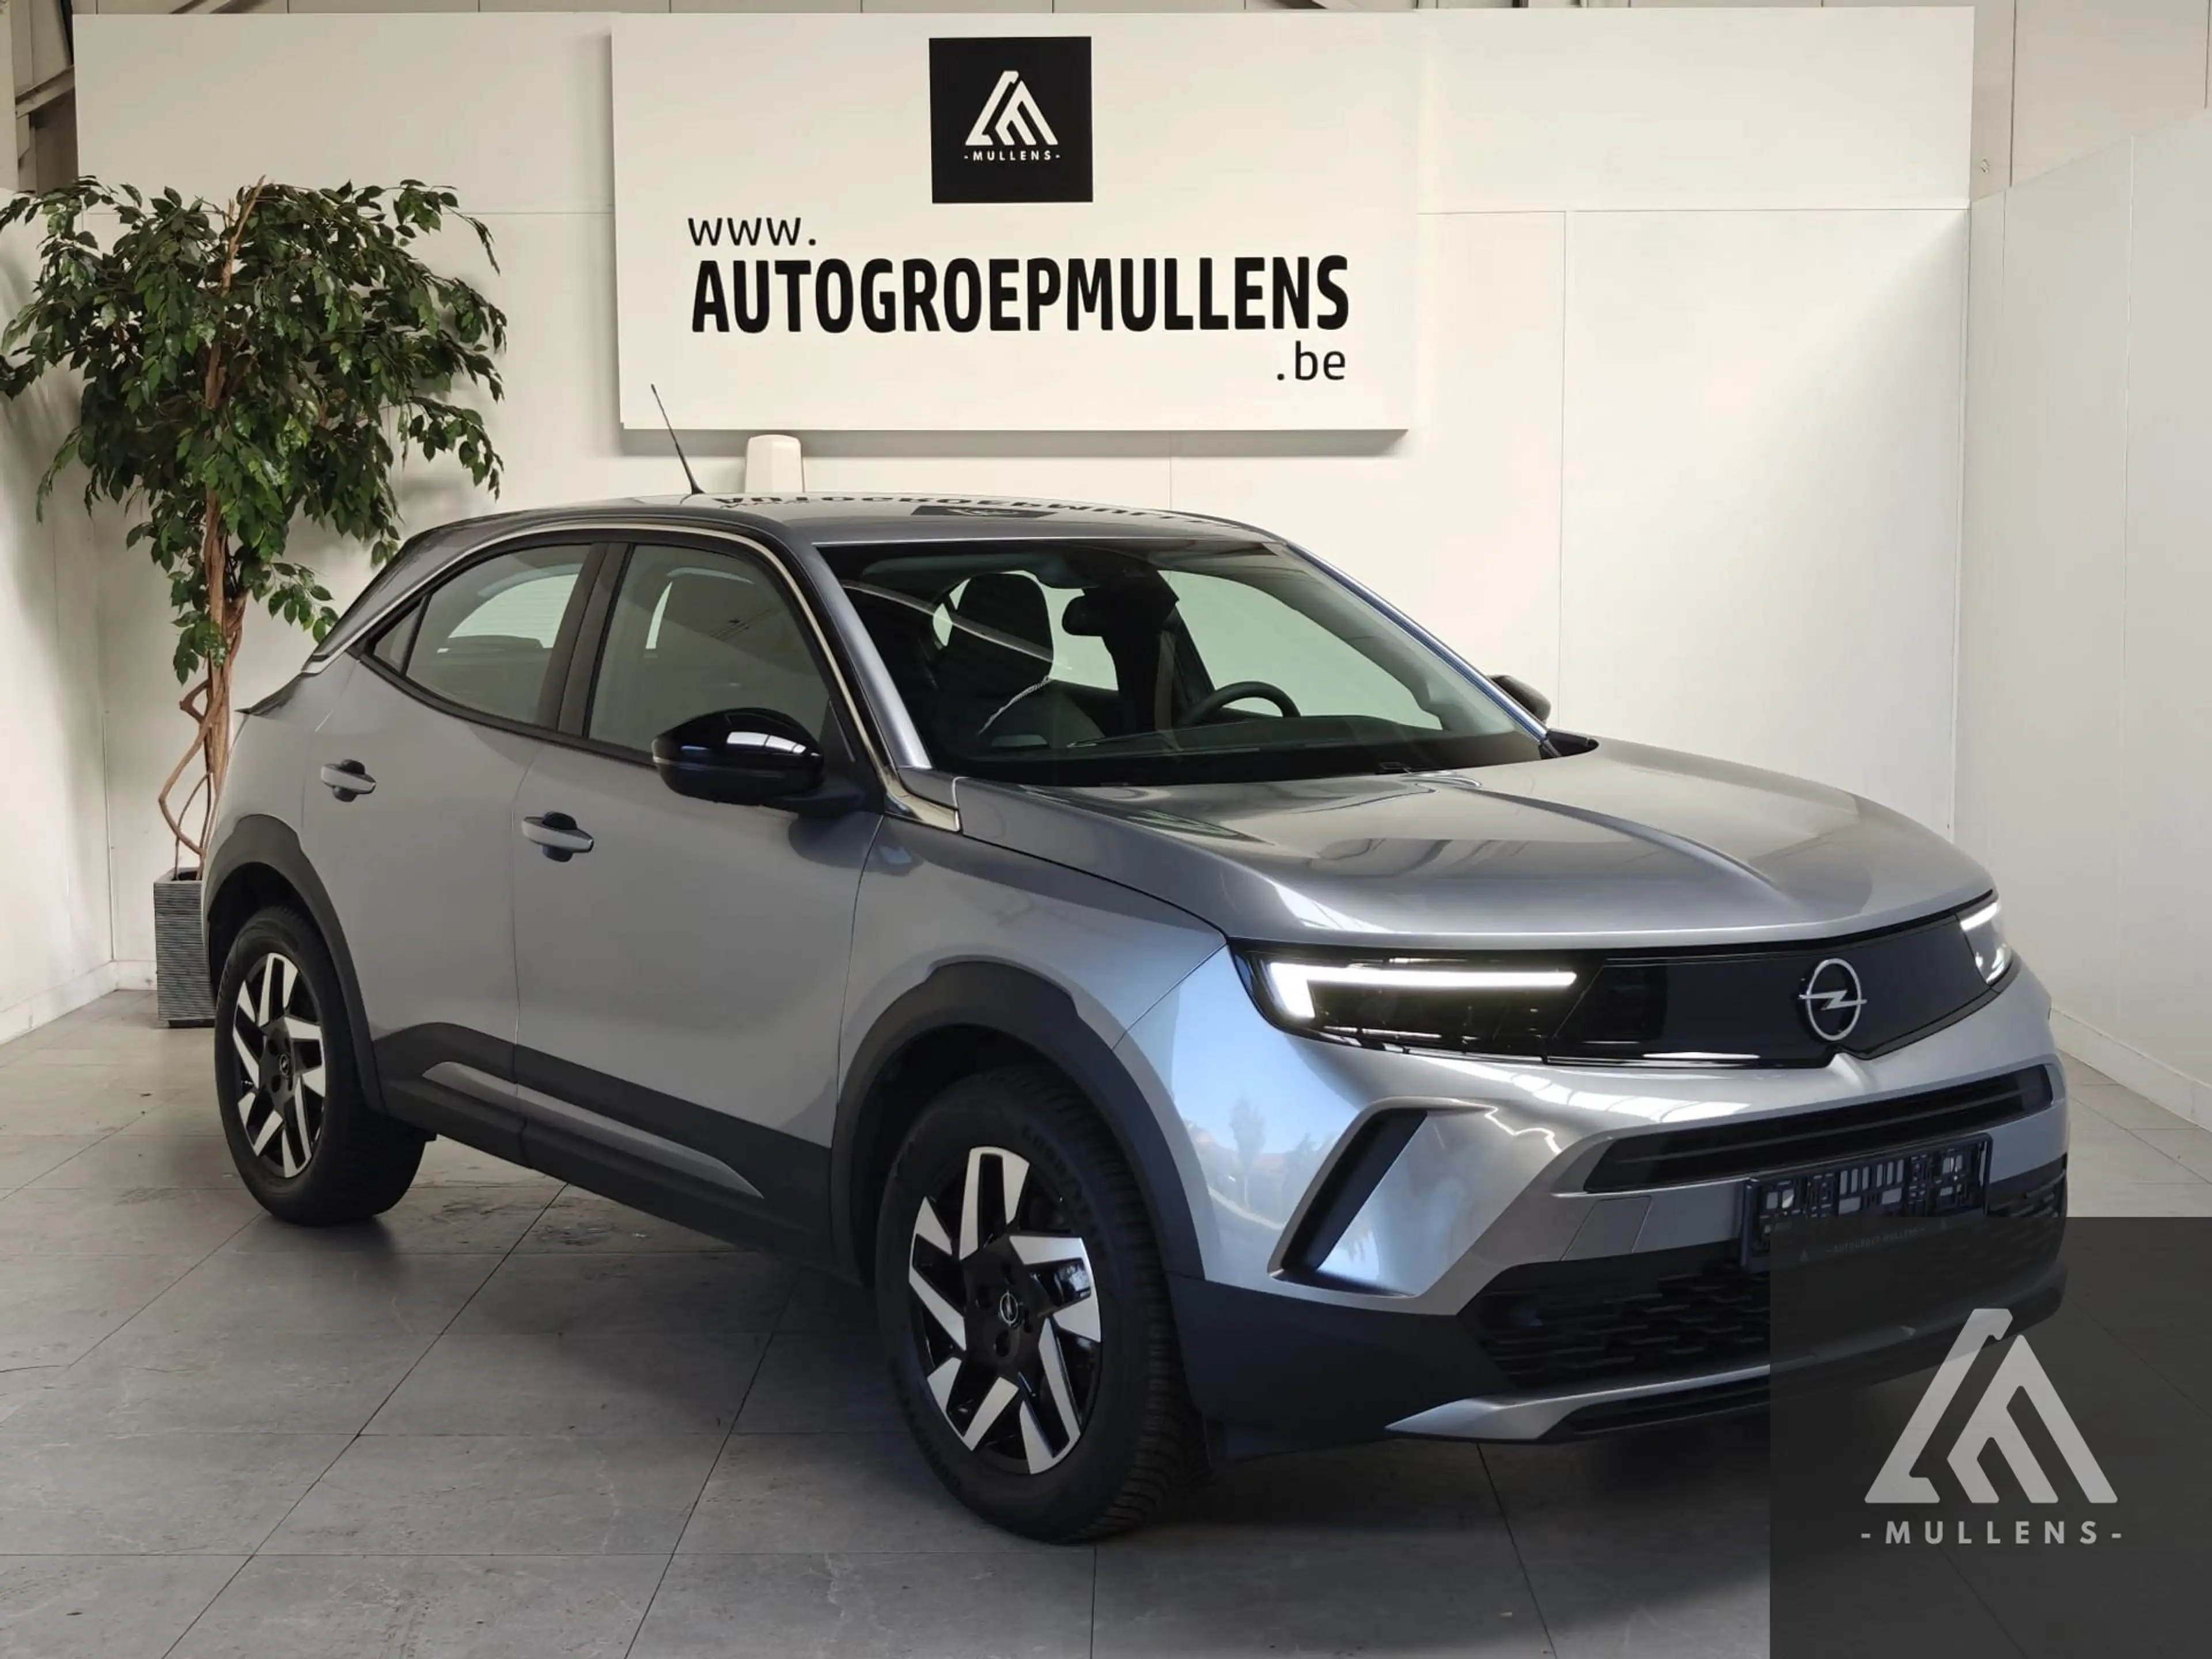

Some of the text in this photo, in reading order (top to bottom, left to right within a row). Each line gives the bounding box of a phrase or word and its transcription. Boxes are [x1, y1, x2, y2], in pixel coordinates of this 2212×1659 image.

[688, 217, 817, 247] www.
[691, 255, 1349, 334] AUTOGROEPMULLENS
[1277, 340, 1346, 381] .be
